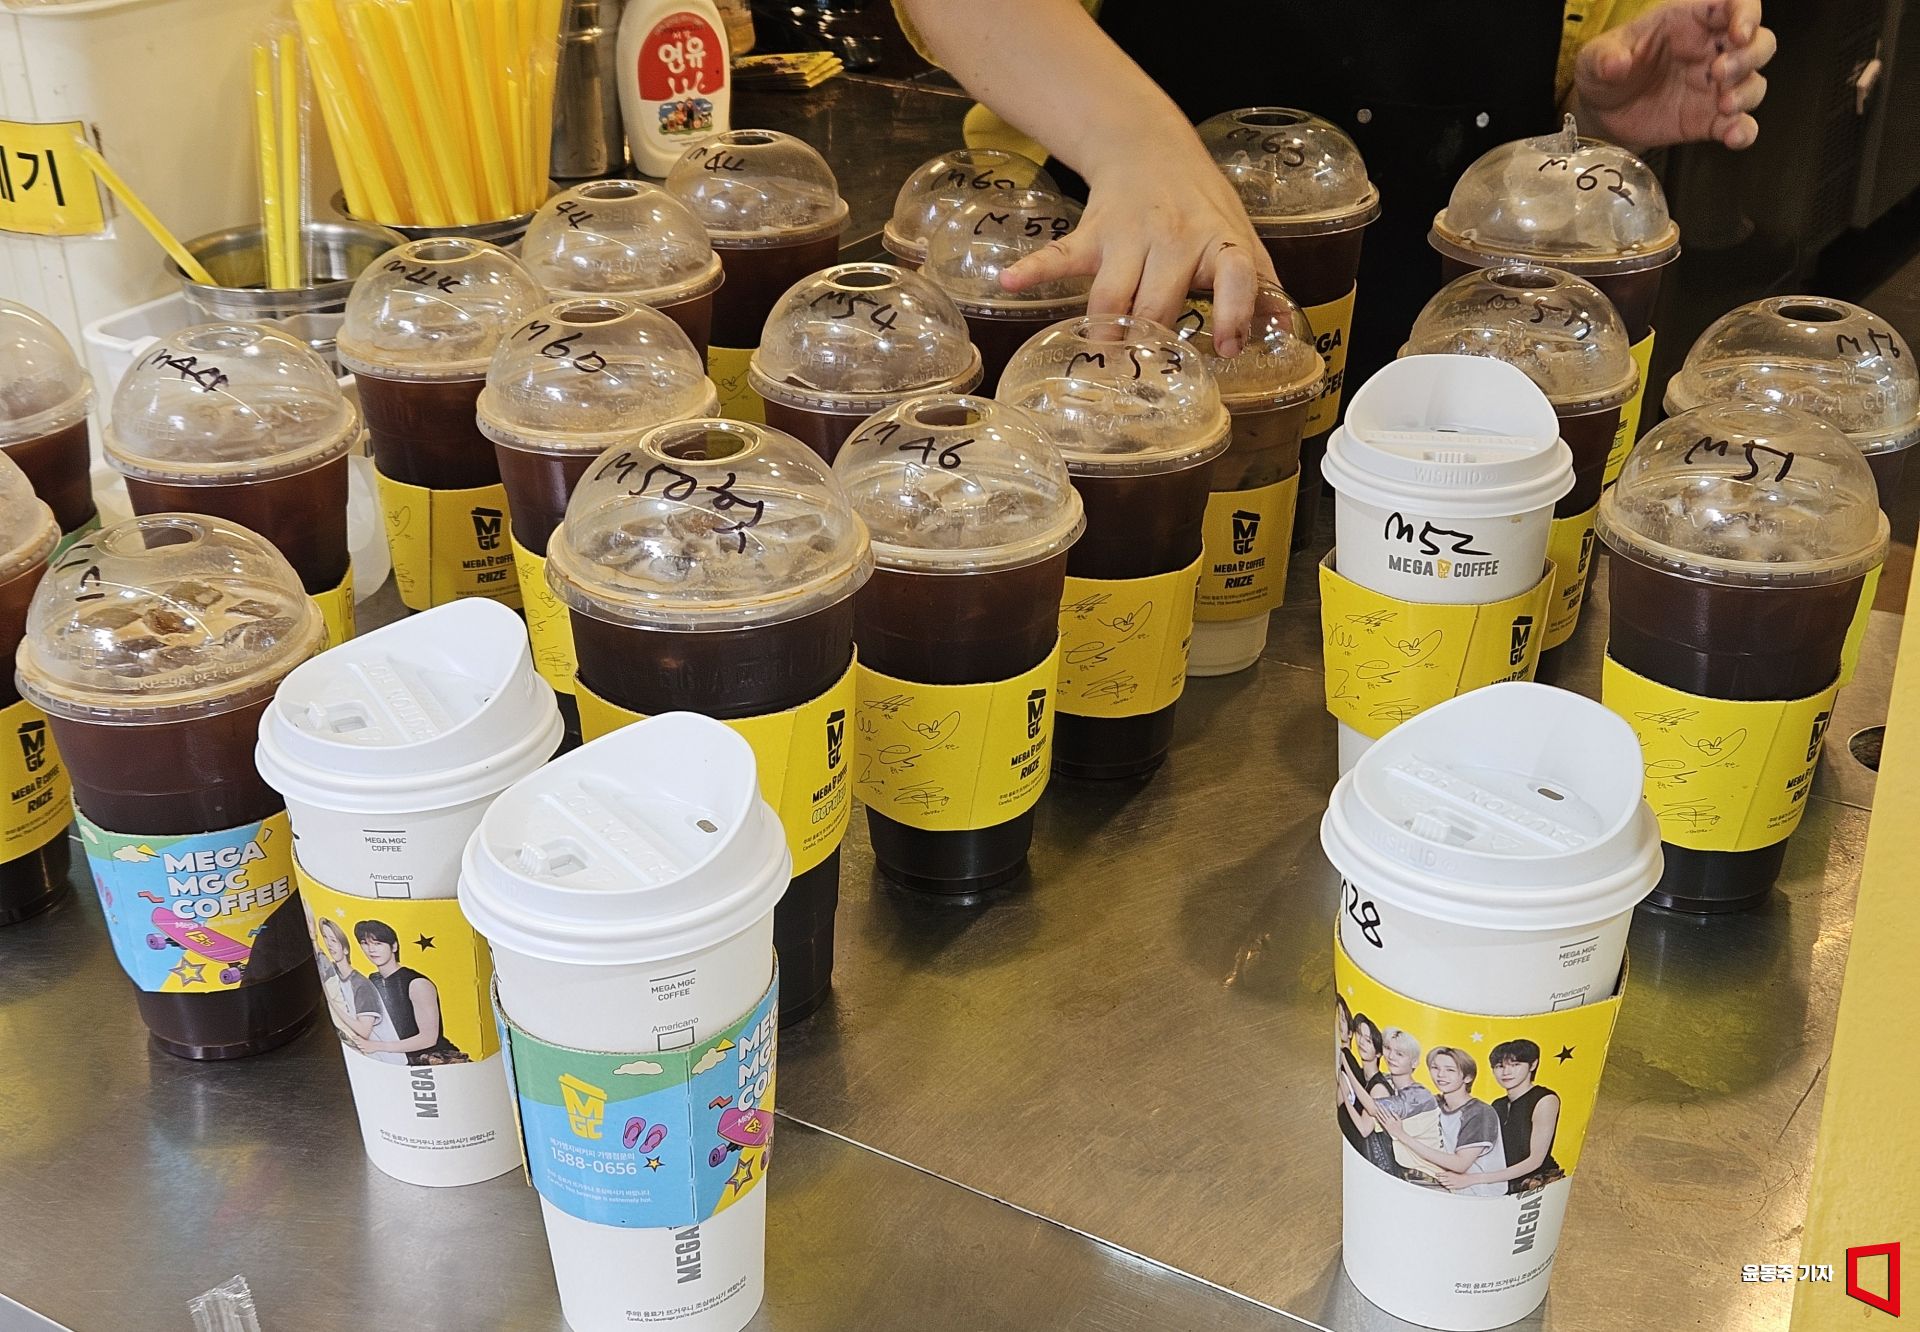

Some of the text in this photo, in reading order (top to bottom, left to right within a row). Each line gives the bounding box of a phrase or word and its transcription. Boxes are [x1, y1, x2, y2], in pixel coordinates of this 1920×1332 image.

[658, 37, 707, 73] 연유
[810, 291, 897, 332] M54
[511, 320, 606, 372] M60
[1384, 512, 1493, 555] M52
[462, 554, 515, 569] MEGA COFFE
[1214, 562, 1237, 573] MEGA
[1388, 554, 1500, 578] MEGA COFFEE
[1011, 750, 1030, 767] MEGA
[812, 784, 832, 803] MEGA
[163, 841, 266, 873] MEGA
[168, 869, 247, 896] MGC
[370, 872, 413, 881] Americano
[172, 876, 290, 919] COFFEE
[1559, 950, 1580, 960] MEGA
[1563, 954, 1591, 967] COFFEE
[651, 977, 696, 994] MEGA MGC
[658, 988, 690, 1001] COFFEE
[1550, 984, 1590, 1000] Americano
[652, 1016, 699, 1033] Americano
[739, 1003, 777, 1061] MEG
[410, 1067, 439, 1118] MEGA
[551, 1147, 637, 1175] 1588-0656
[1512, 1195, 1544, 1255] MEGA
[675, 1225, 701, 1284] MEGA
